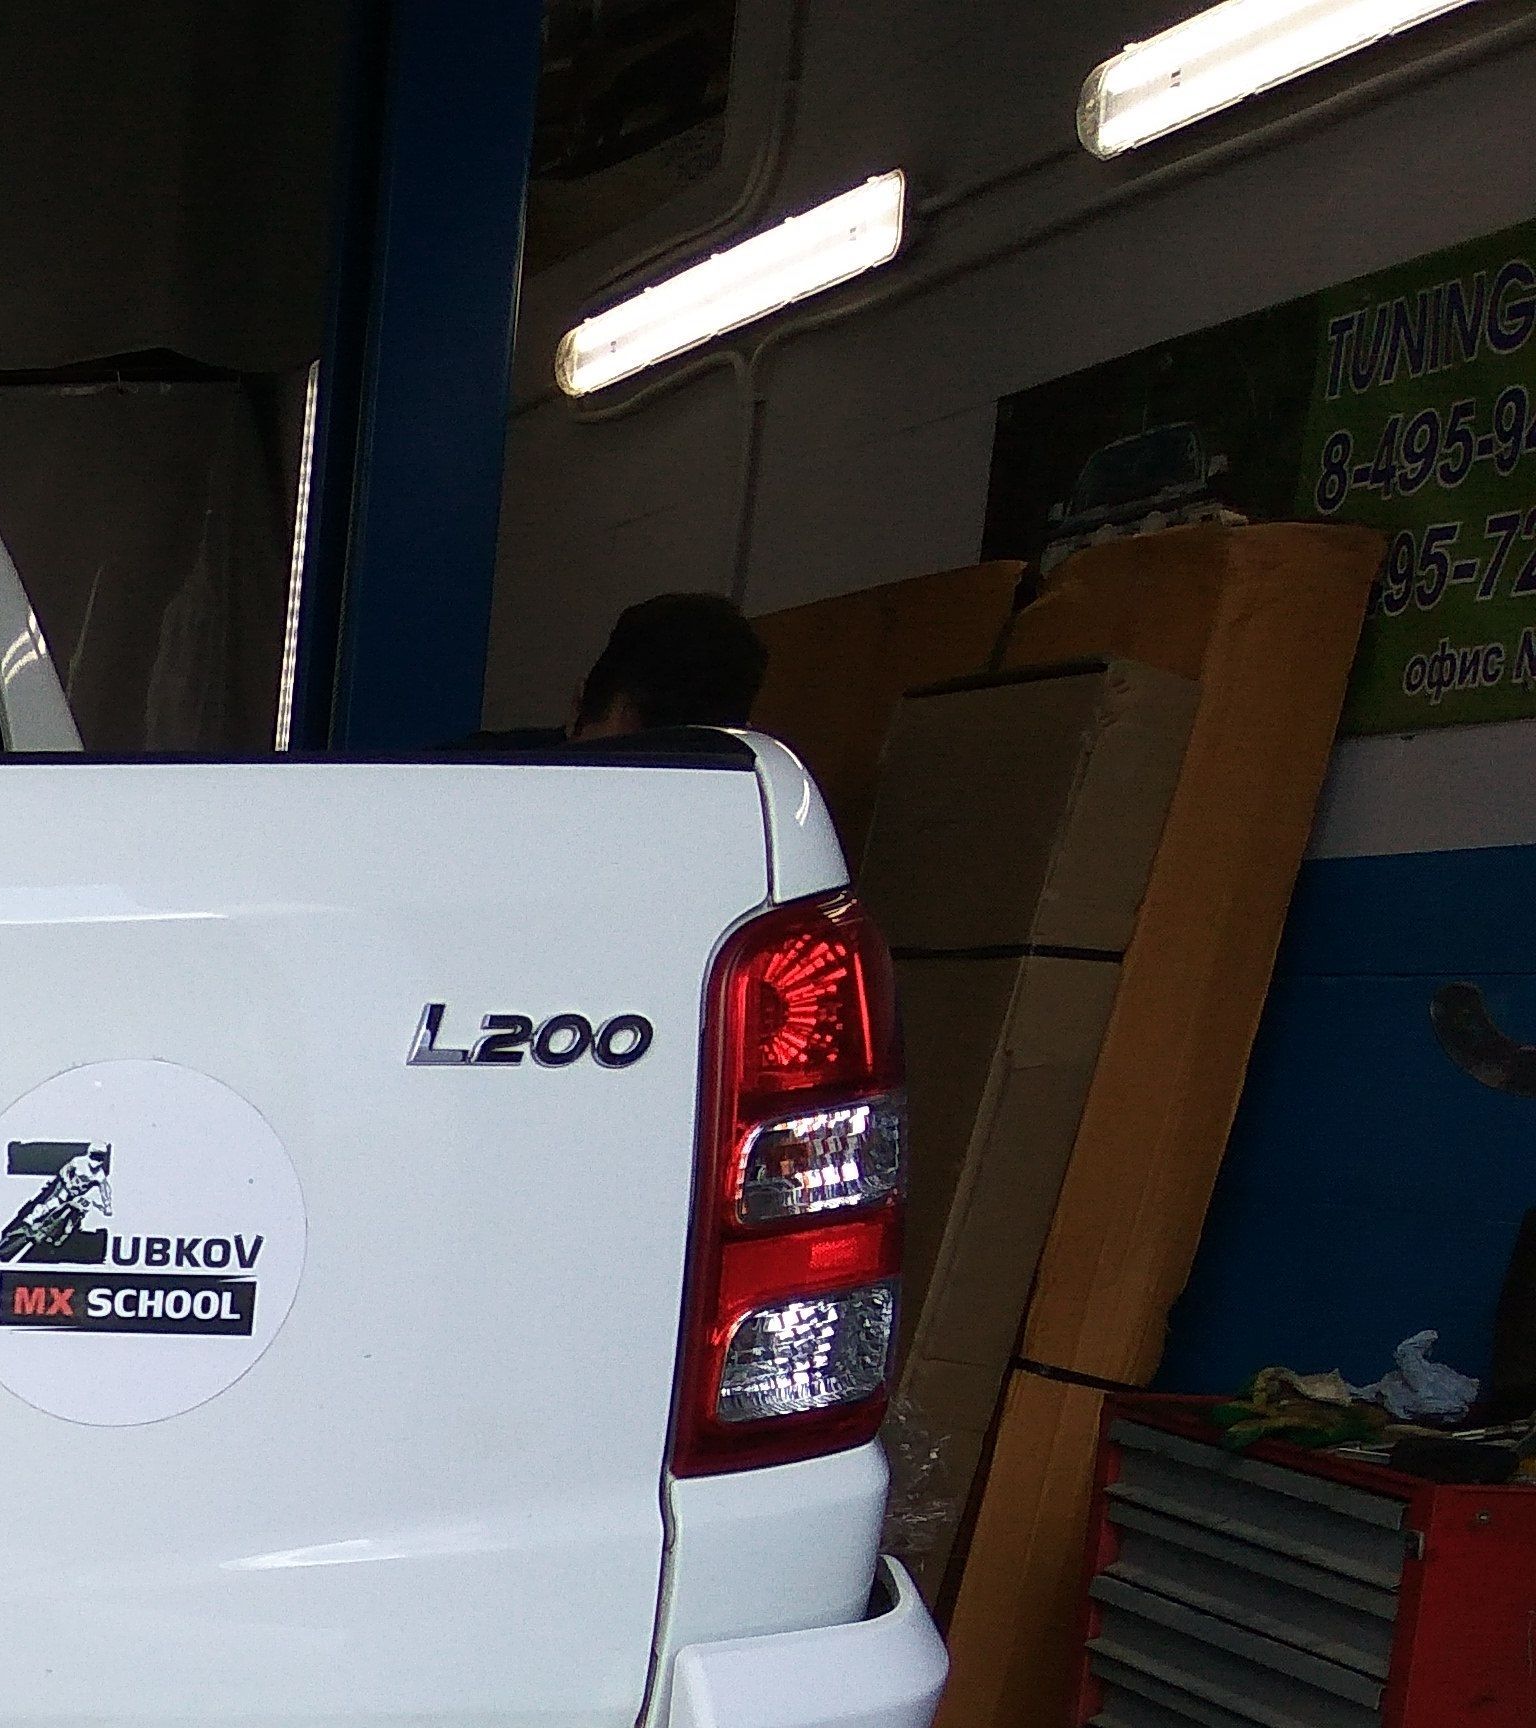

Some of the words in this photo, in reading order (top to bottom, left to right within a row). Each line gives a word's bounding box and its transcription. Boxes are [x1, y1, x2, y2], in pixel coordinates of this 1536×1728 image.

[1325, 260, 1536, 400] TUNING
[1403, 636, 1505, 706] офис
[406, 1003, 654, 1069] L200
[12, 1286, 75, 1317] MX
[86, 1287, 241, 1320] SCHOOL
